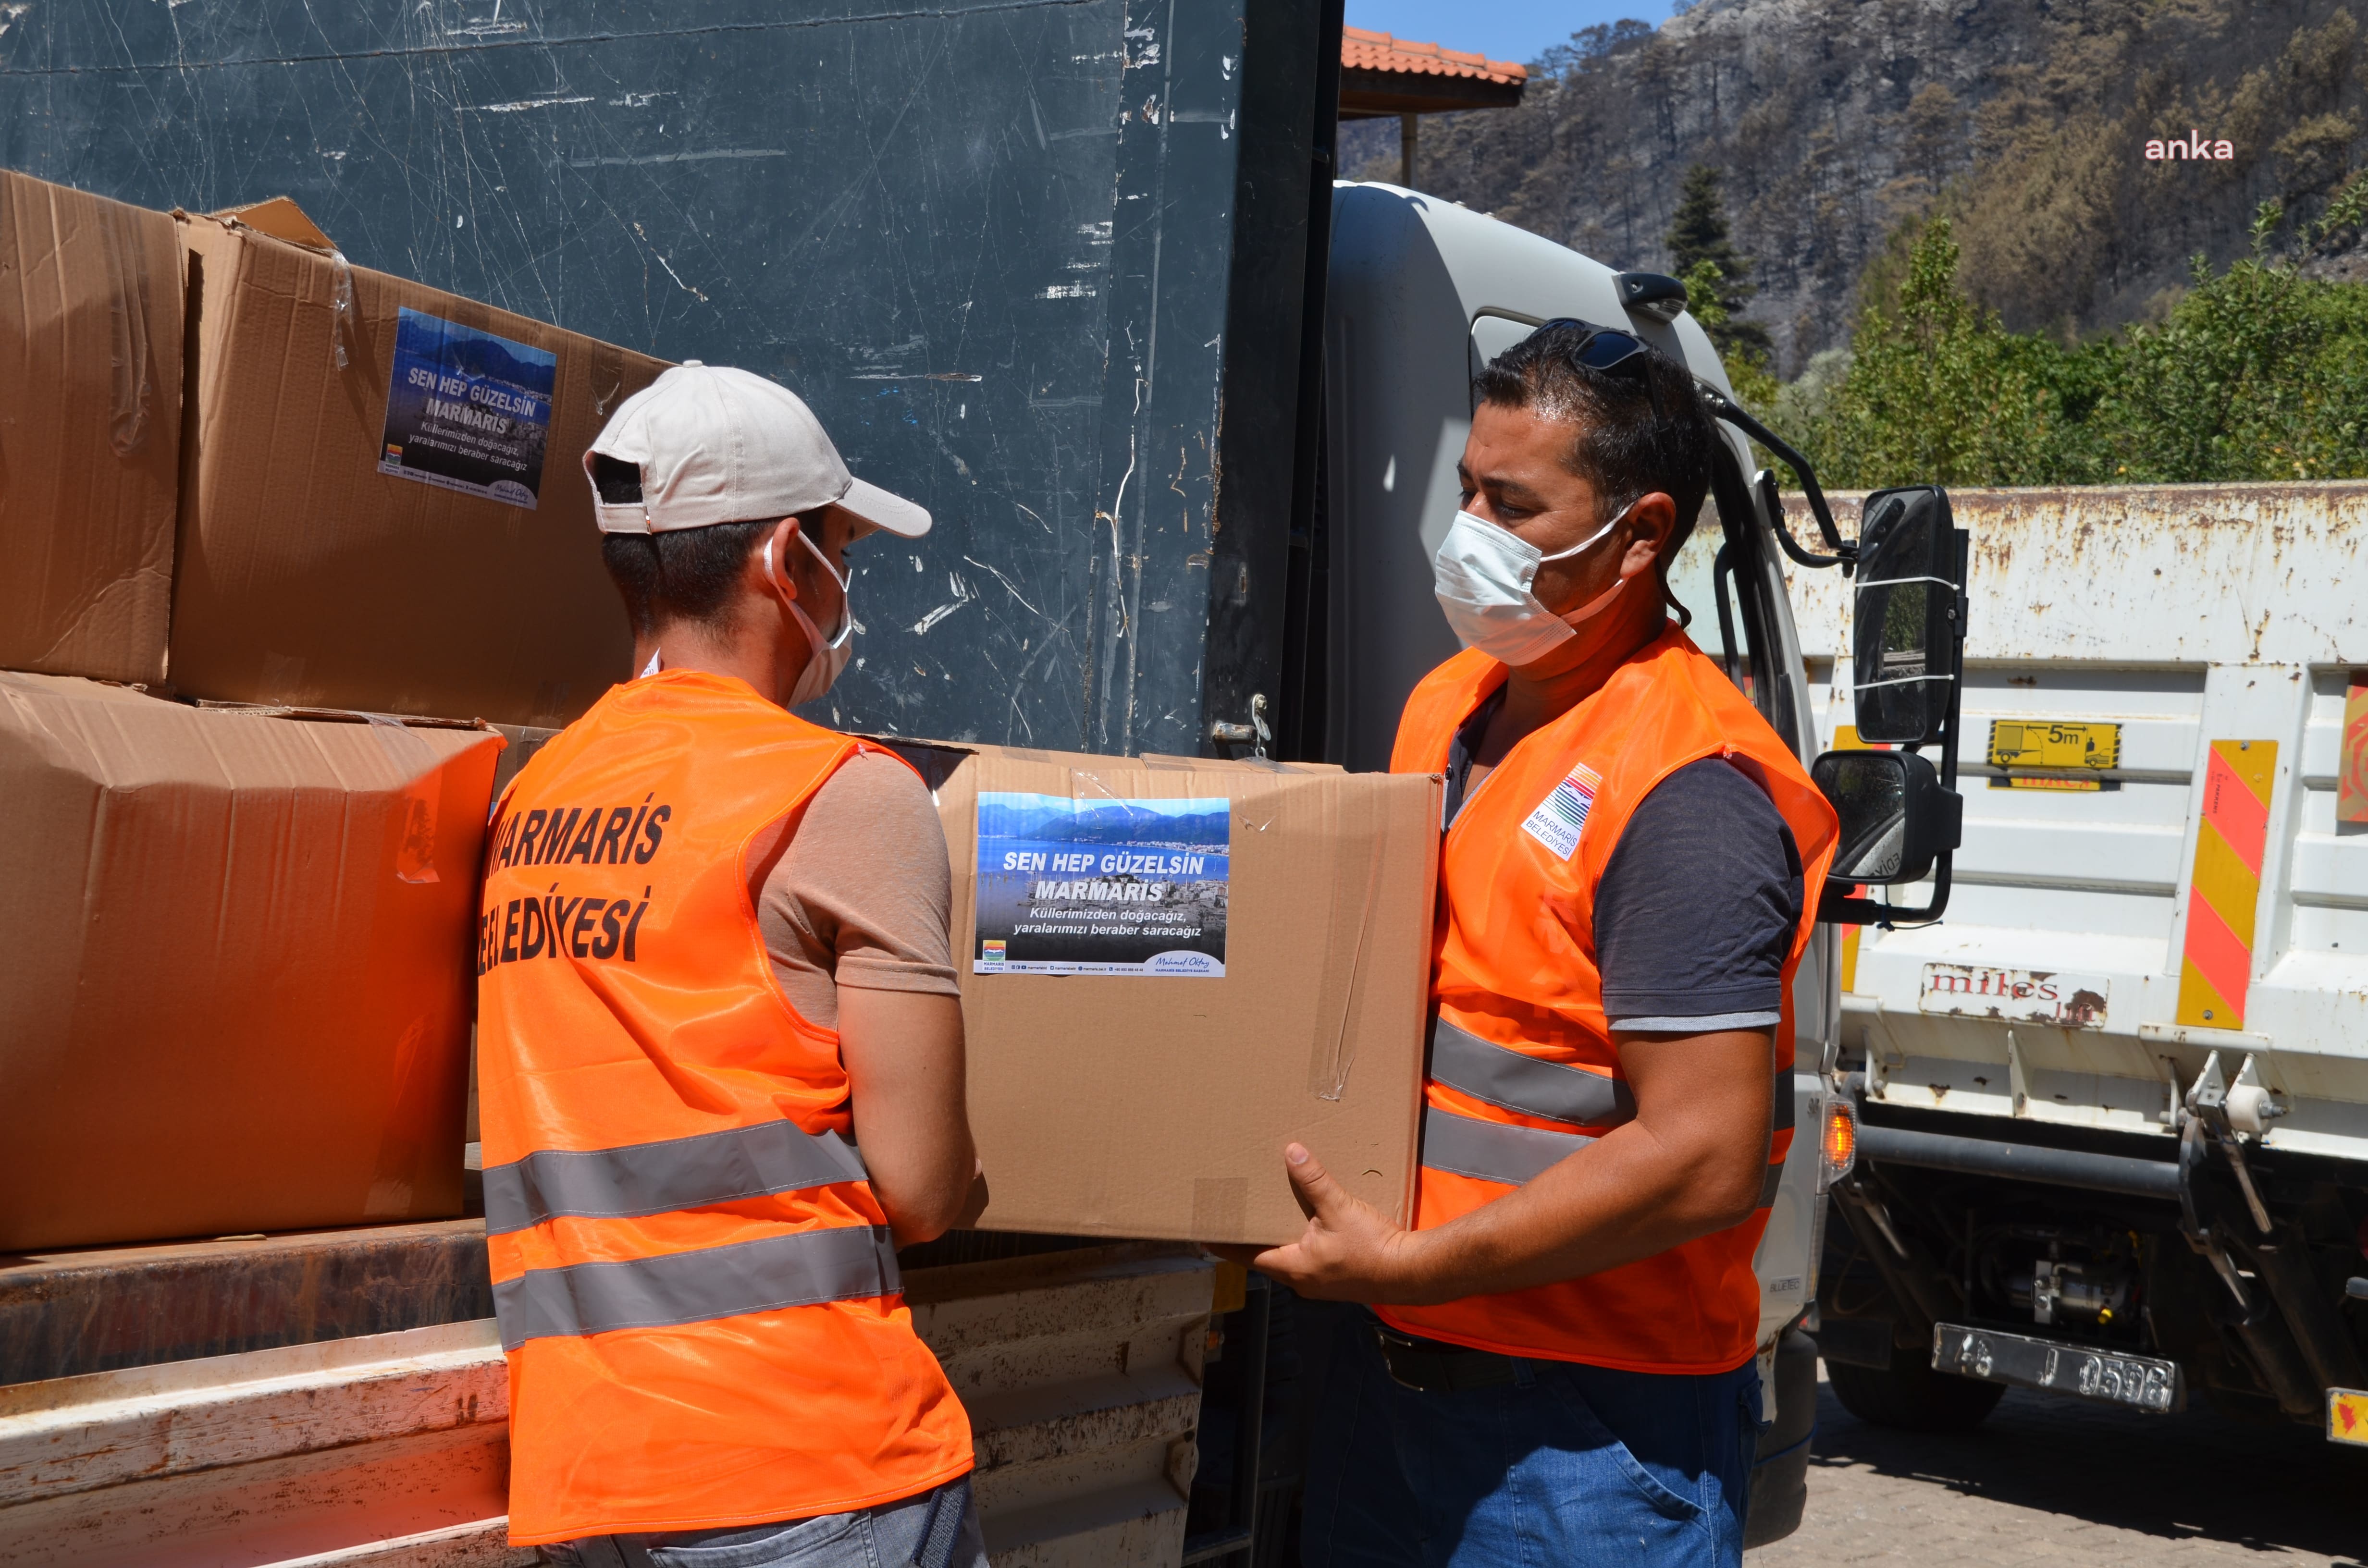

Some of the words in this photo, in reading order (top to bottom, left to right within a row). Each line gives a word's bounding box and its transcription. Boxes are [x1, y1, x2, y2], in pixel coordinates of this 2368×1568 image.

[408, 368, 436, 389] SEN
[439, 376, 467, 396] HEP
[470, 385, 536, 417] GÜZELSİN
[426, 398, 506, 434] MARMARİS
[409, 434, 456, 453] yaralarımızı
[458, 445, 489, 461] beraber
[490, 455, 527, 471] saracağız
[421, 421, 476, 444] Küllerimizden
[478, 437, 519, 456] doğacağız,
[2048, 724, 2079, 745] 5m
[487, 792, 671, 879] MARMARİS
[1526, 820, 1572, 856] BELEDİYESİ
[1533, 811, 1577, 847] MARMARİS
[1003, 852, 1047, 871] SEN
[1052, 854, 1095, 872] HEP
[1100, 851, 1205, 875] GÜZELSİN
[1035, 879, 1163, 902] MARMARİS
[1013, 923, 1087, 936] yaralarımızı
[1091, 924, 1138, 935] beraber
[1142, 925, 1201, 939] saracağız
[1030, 907, 1117, 920] Küllerimizden
[1120, 909, 1187, 923] doğacağız,
[1155, 957, 1188, 967] Mehmet
[1929, 971, 2059, 1001] miles
